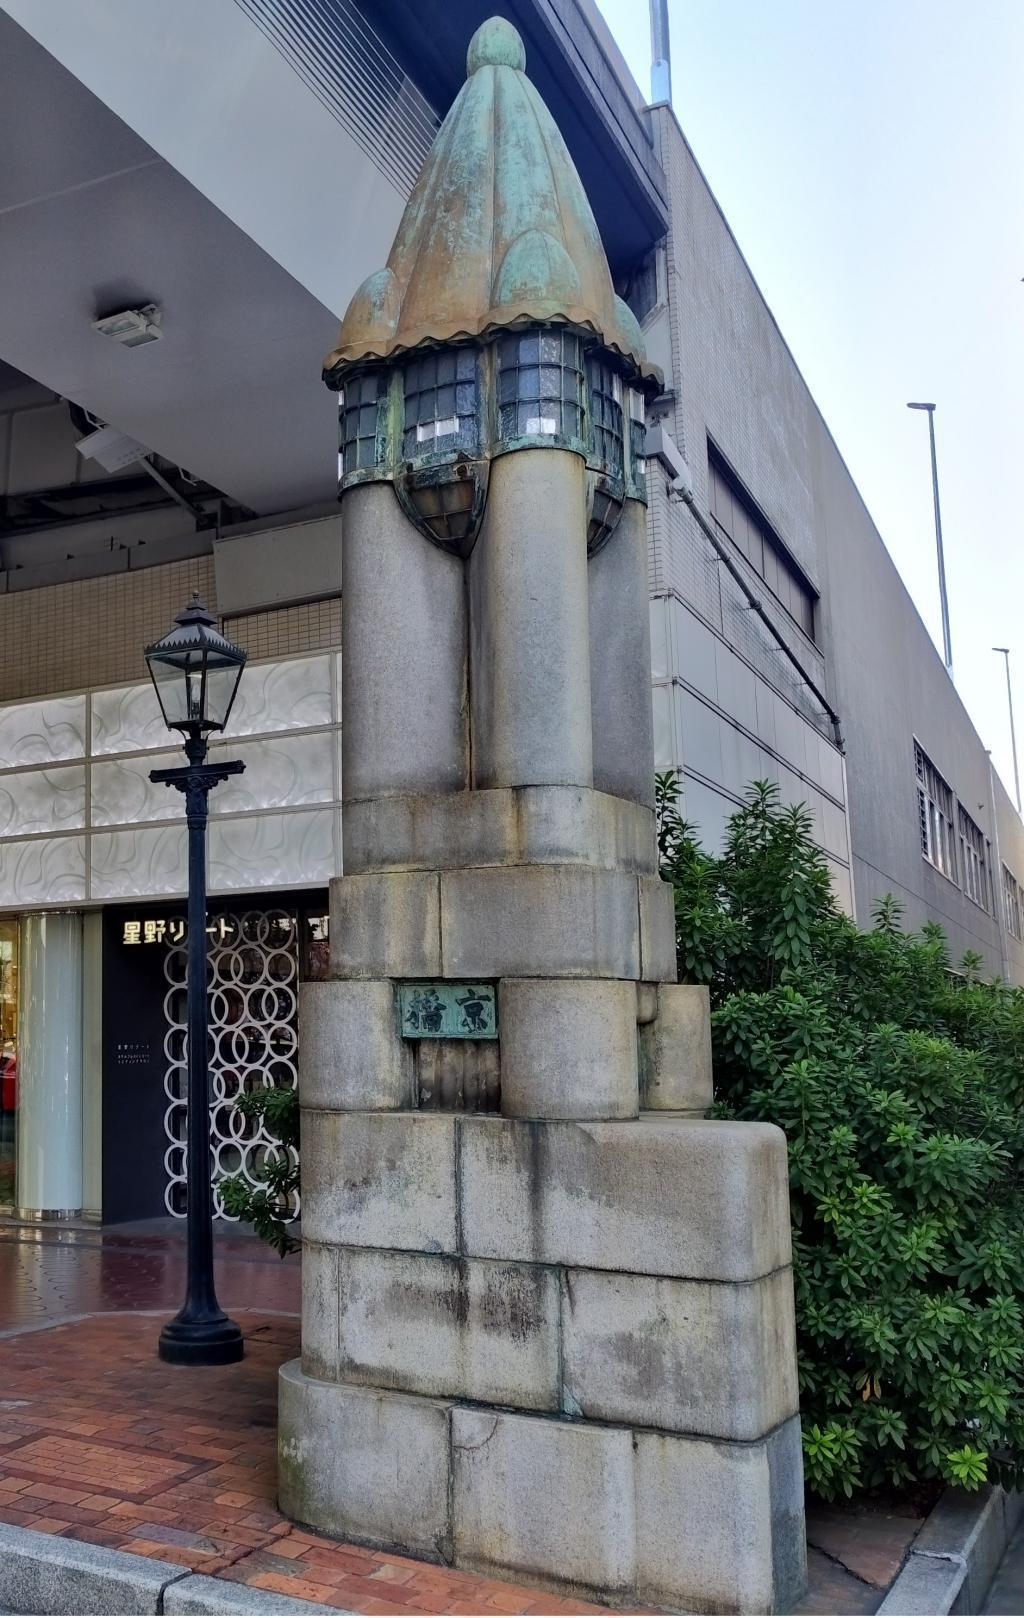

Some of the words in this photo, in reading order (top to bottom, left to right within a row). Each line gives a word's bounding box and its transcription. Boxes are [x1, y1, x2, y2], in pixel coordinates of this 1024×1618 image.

[122, 915, 234, 945] 星野リート
